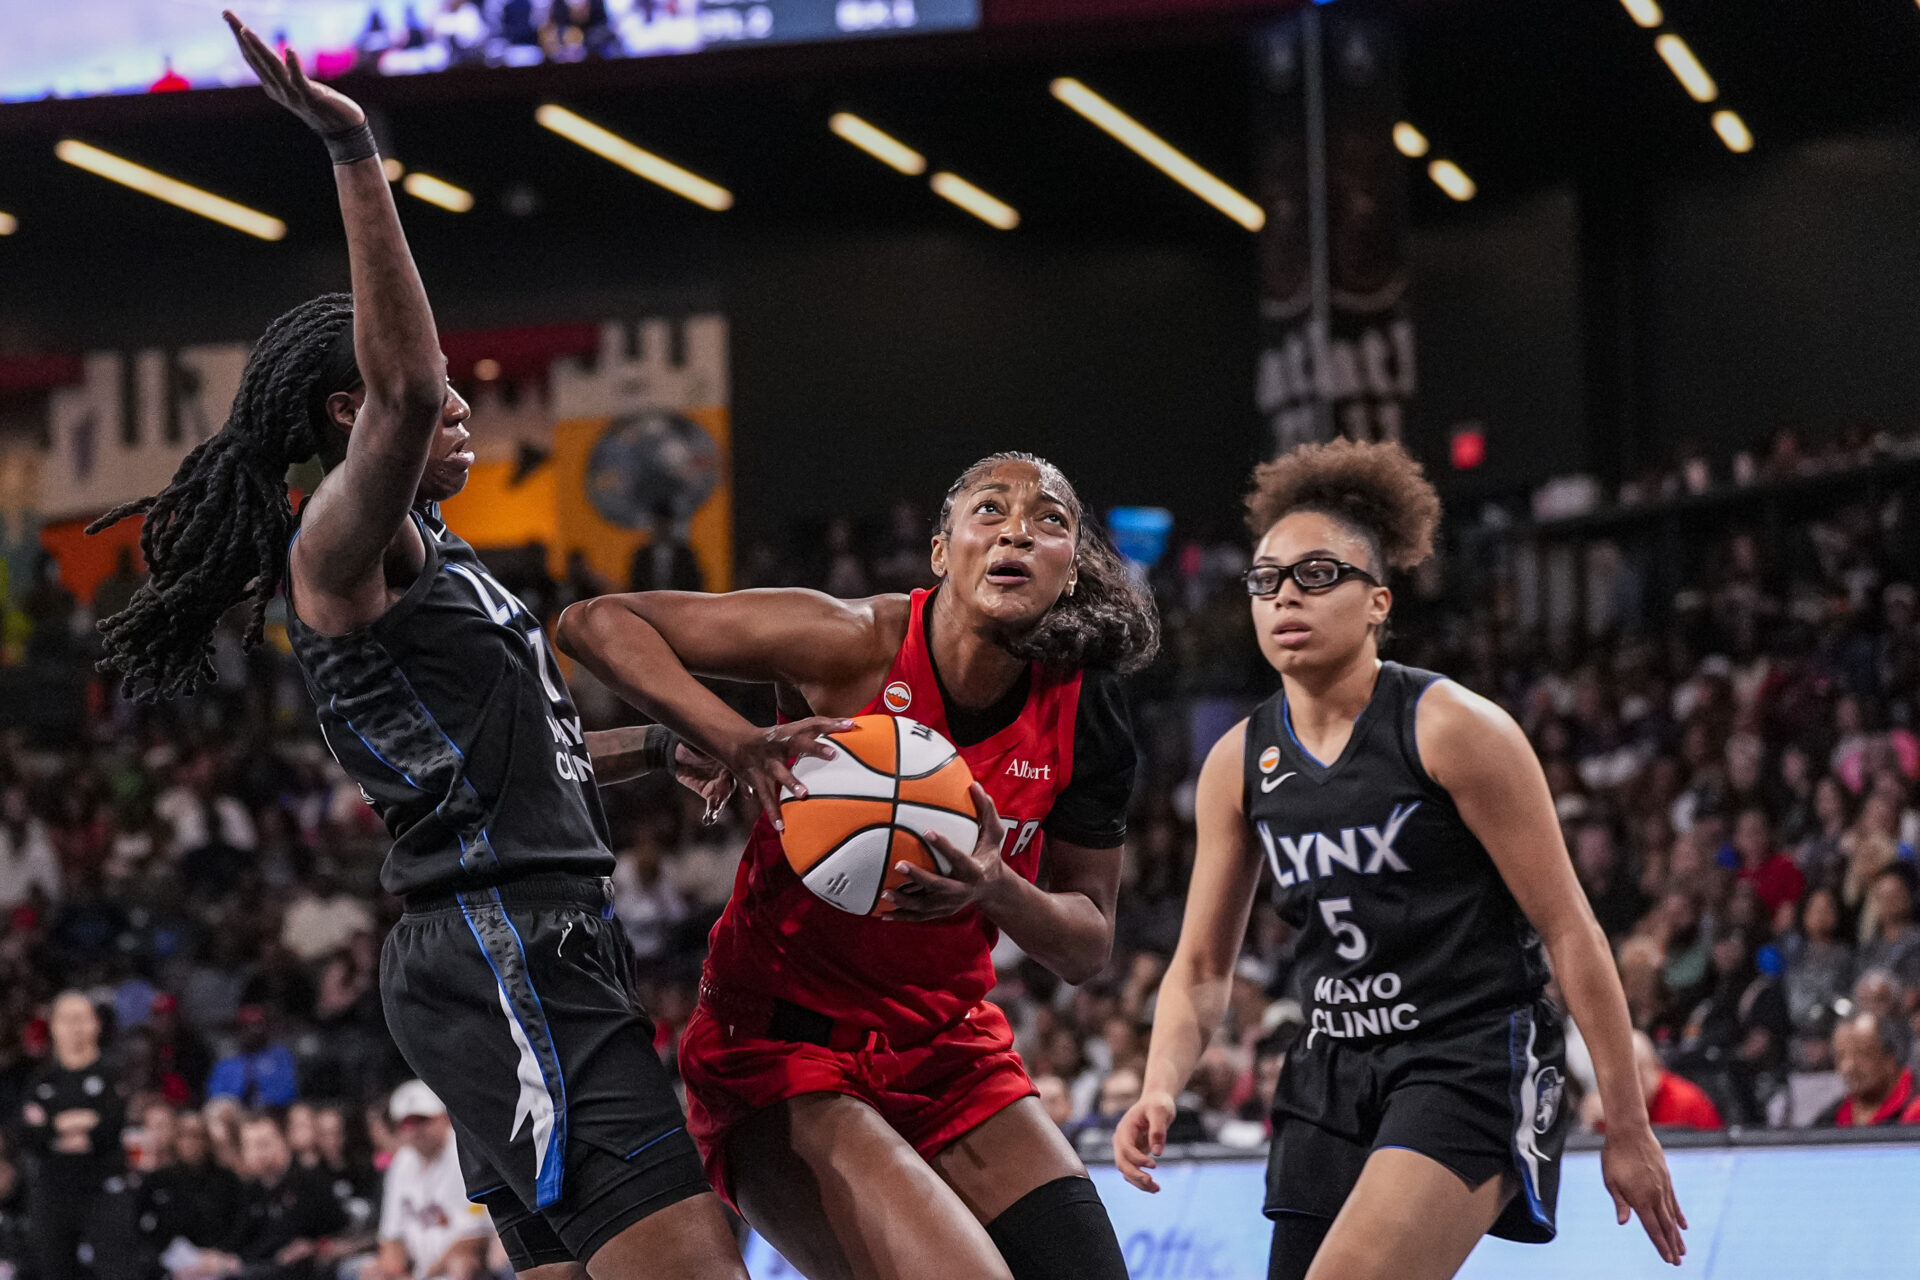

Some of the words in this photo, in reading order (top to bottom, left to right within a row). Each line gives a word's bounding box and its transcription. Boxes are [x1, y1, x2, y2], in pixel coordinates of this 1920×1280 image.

[545, 714, 584, 747] MAY
[1005, 758, 1051, 781] Albert
[1256, 800, 1422, 889] LYNX
[1318, 896, 1368, 961] 5
[1313, 972, 1402, 1006] MAYO
[1311, 1003, 1421, 1039] CLINIC
